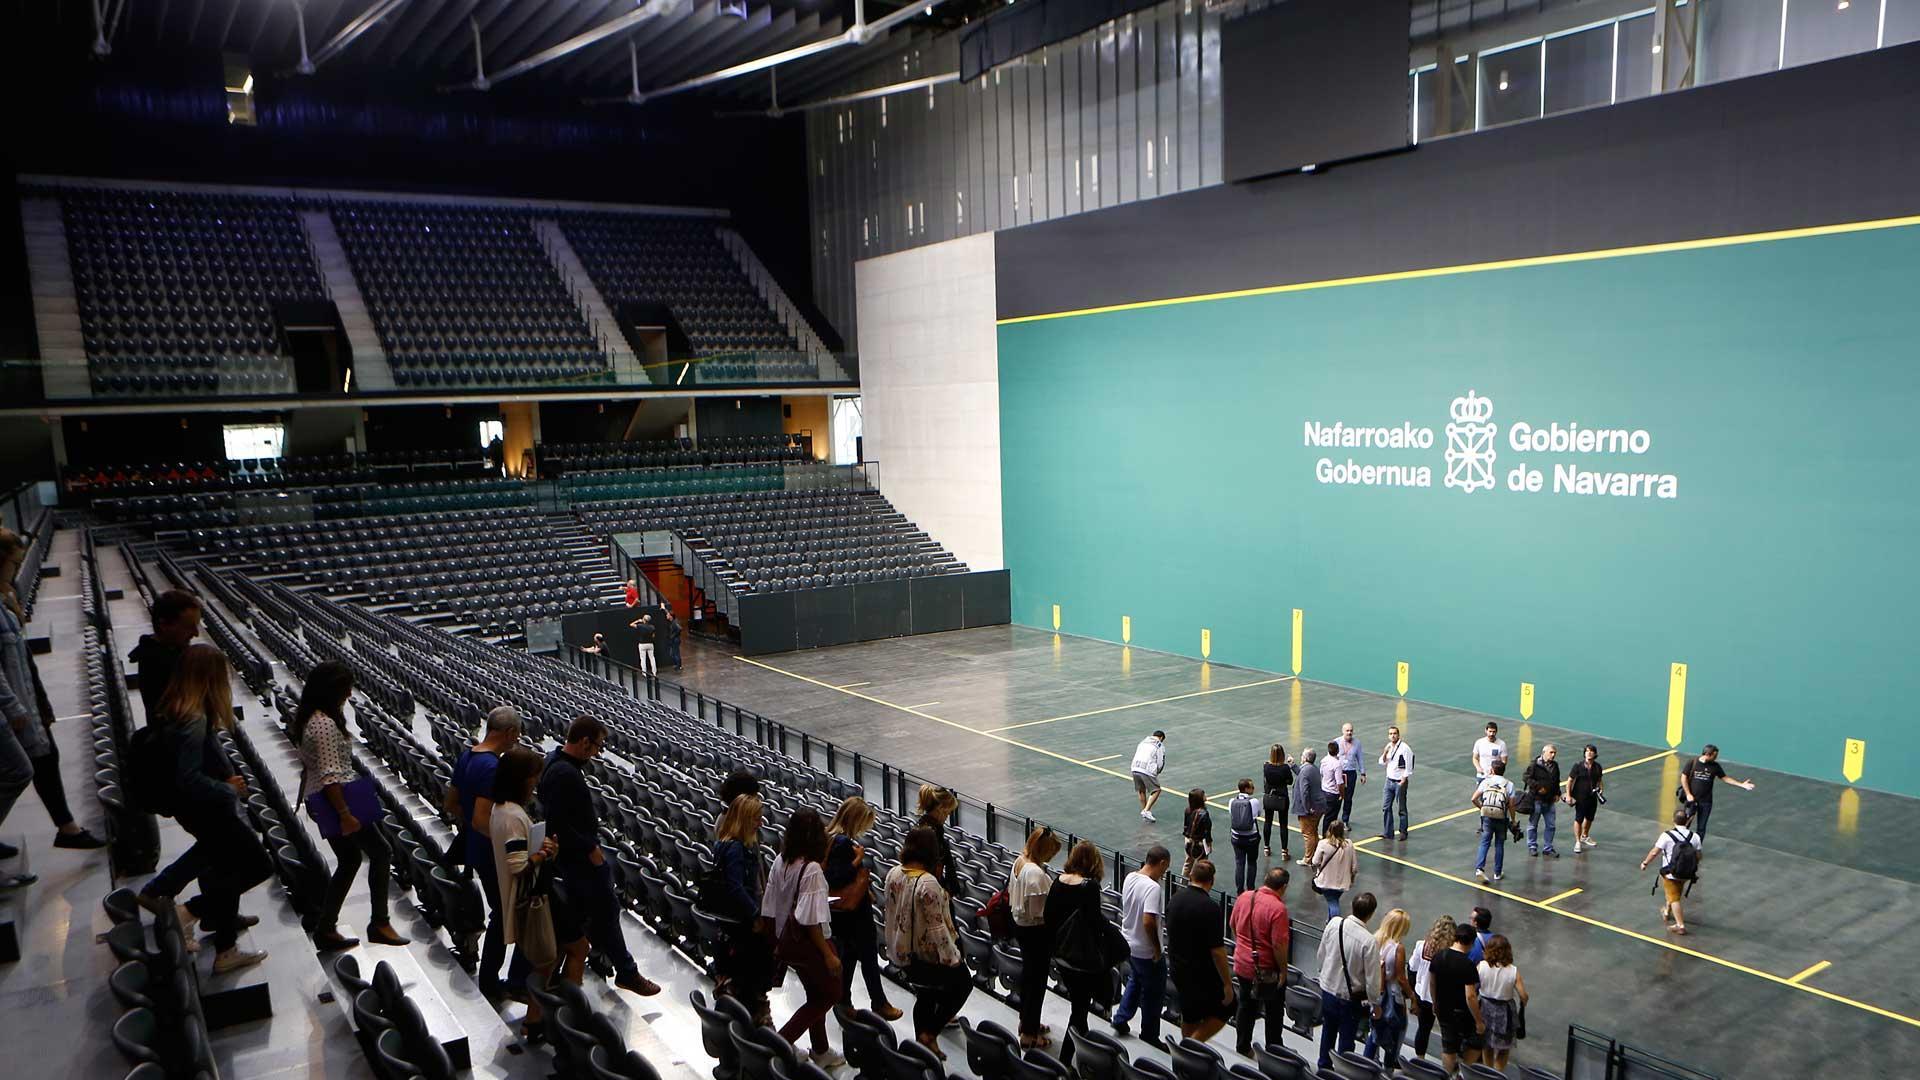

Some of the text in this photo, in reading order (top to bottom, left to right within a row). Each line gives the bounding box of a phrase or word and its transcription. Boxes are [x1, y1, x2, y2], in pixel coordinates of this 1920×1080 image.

[1304, 421, 1434, 449] Nafarroako
[1509, 421, 1651, 454] Gobierno
[1315, 457, 1431, 487] Gobernua
[1507, 462, 1678, 498] de Navarra
[1400, 665, 1406, 674] 6
[1675, 666, 1682, 677] 4
[1524, 685, 1531, 696] 5
[1850, 742, 1859, 754] 3
